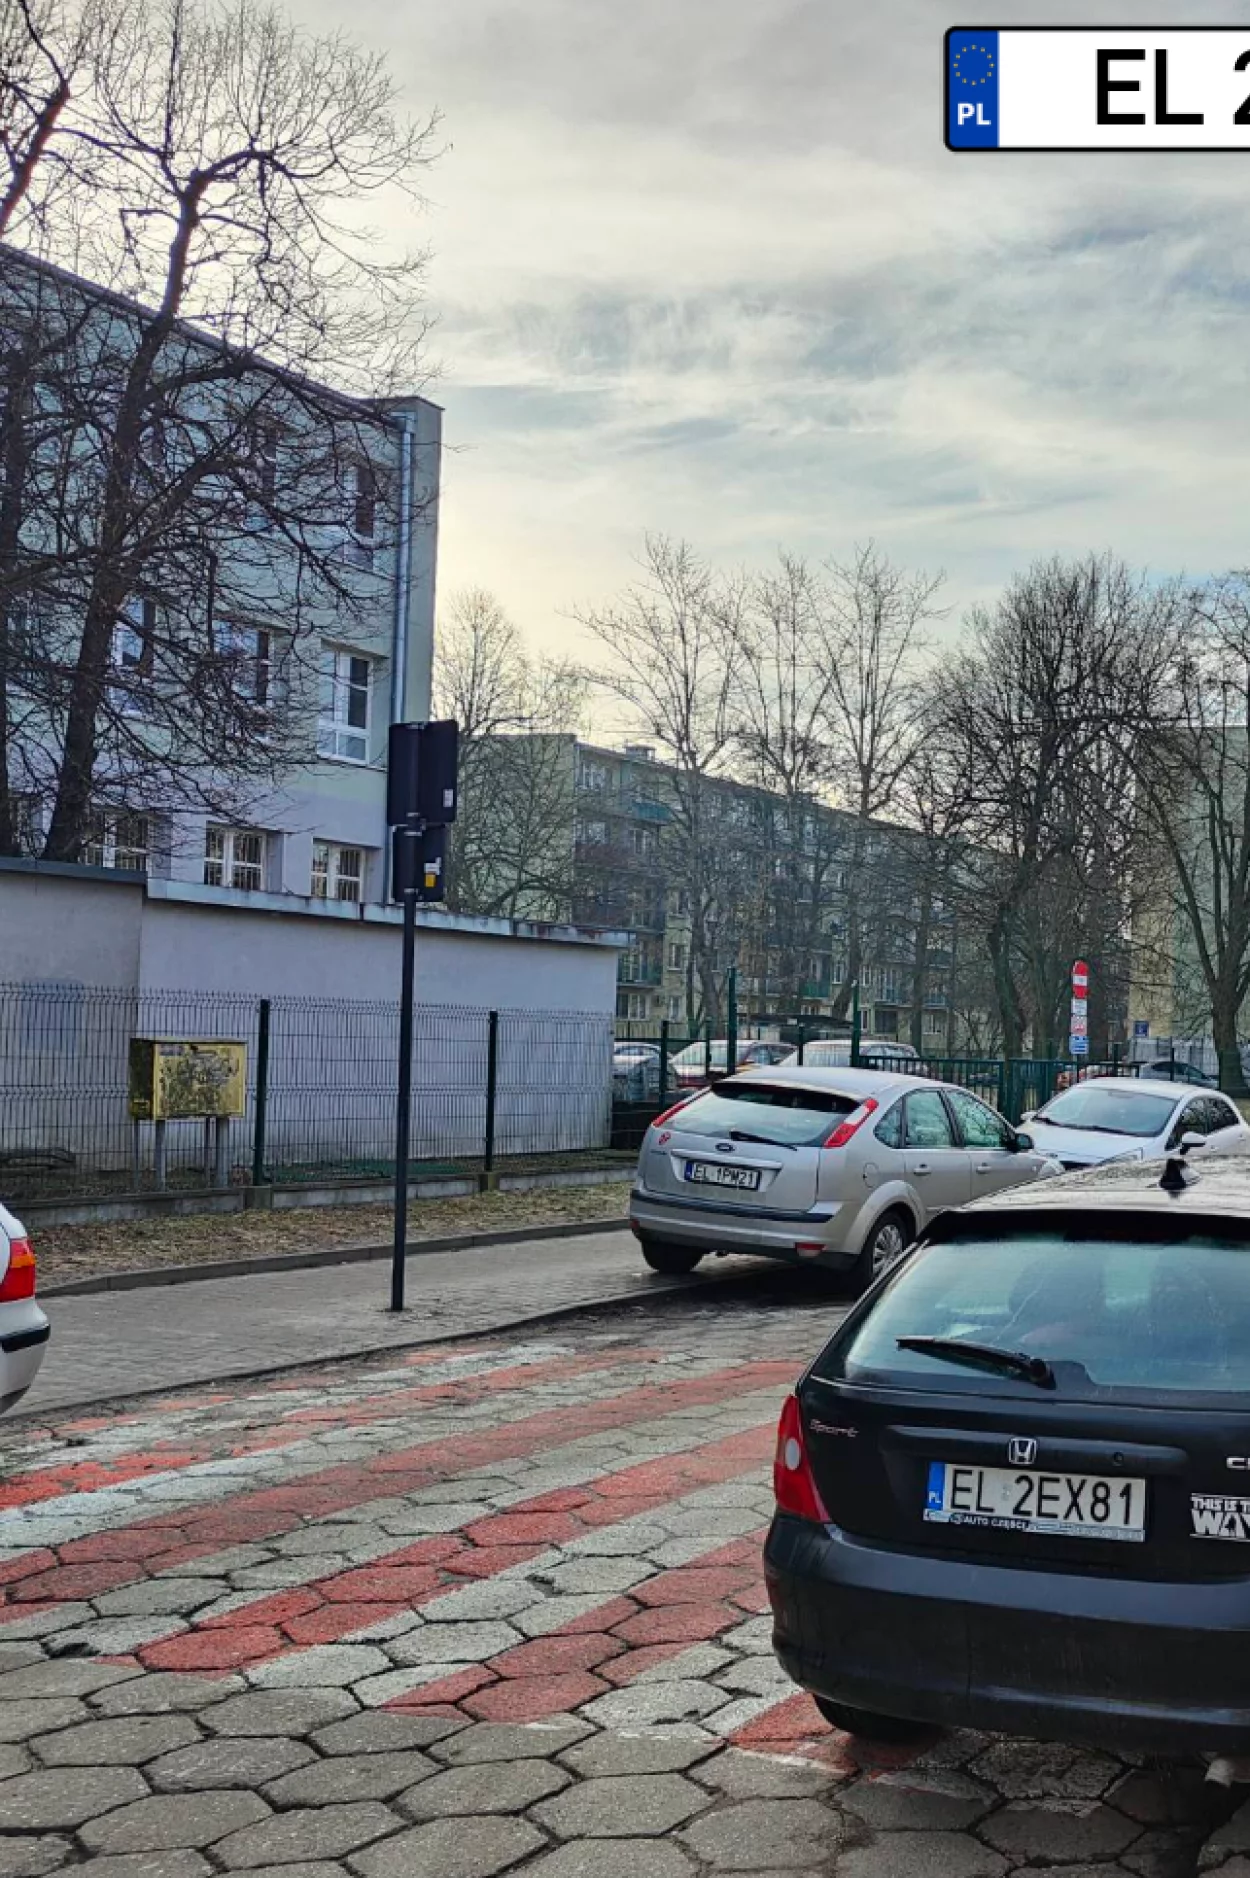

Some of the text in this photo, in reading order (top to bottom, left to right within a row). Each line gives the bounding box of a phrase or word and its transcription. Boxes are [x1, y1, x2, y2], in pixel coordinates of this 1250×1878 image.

[695, 1162, 707, 1180] EL
[951, 1468, 1132, 1526] EL 2EX81
[1190, 1496, 1224, 1511] THIS
[1224, 1499, 1239, 1512] IS
[963, 1516, 989, 1527] AUTO
